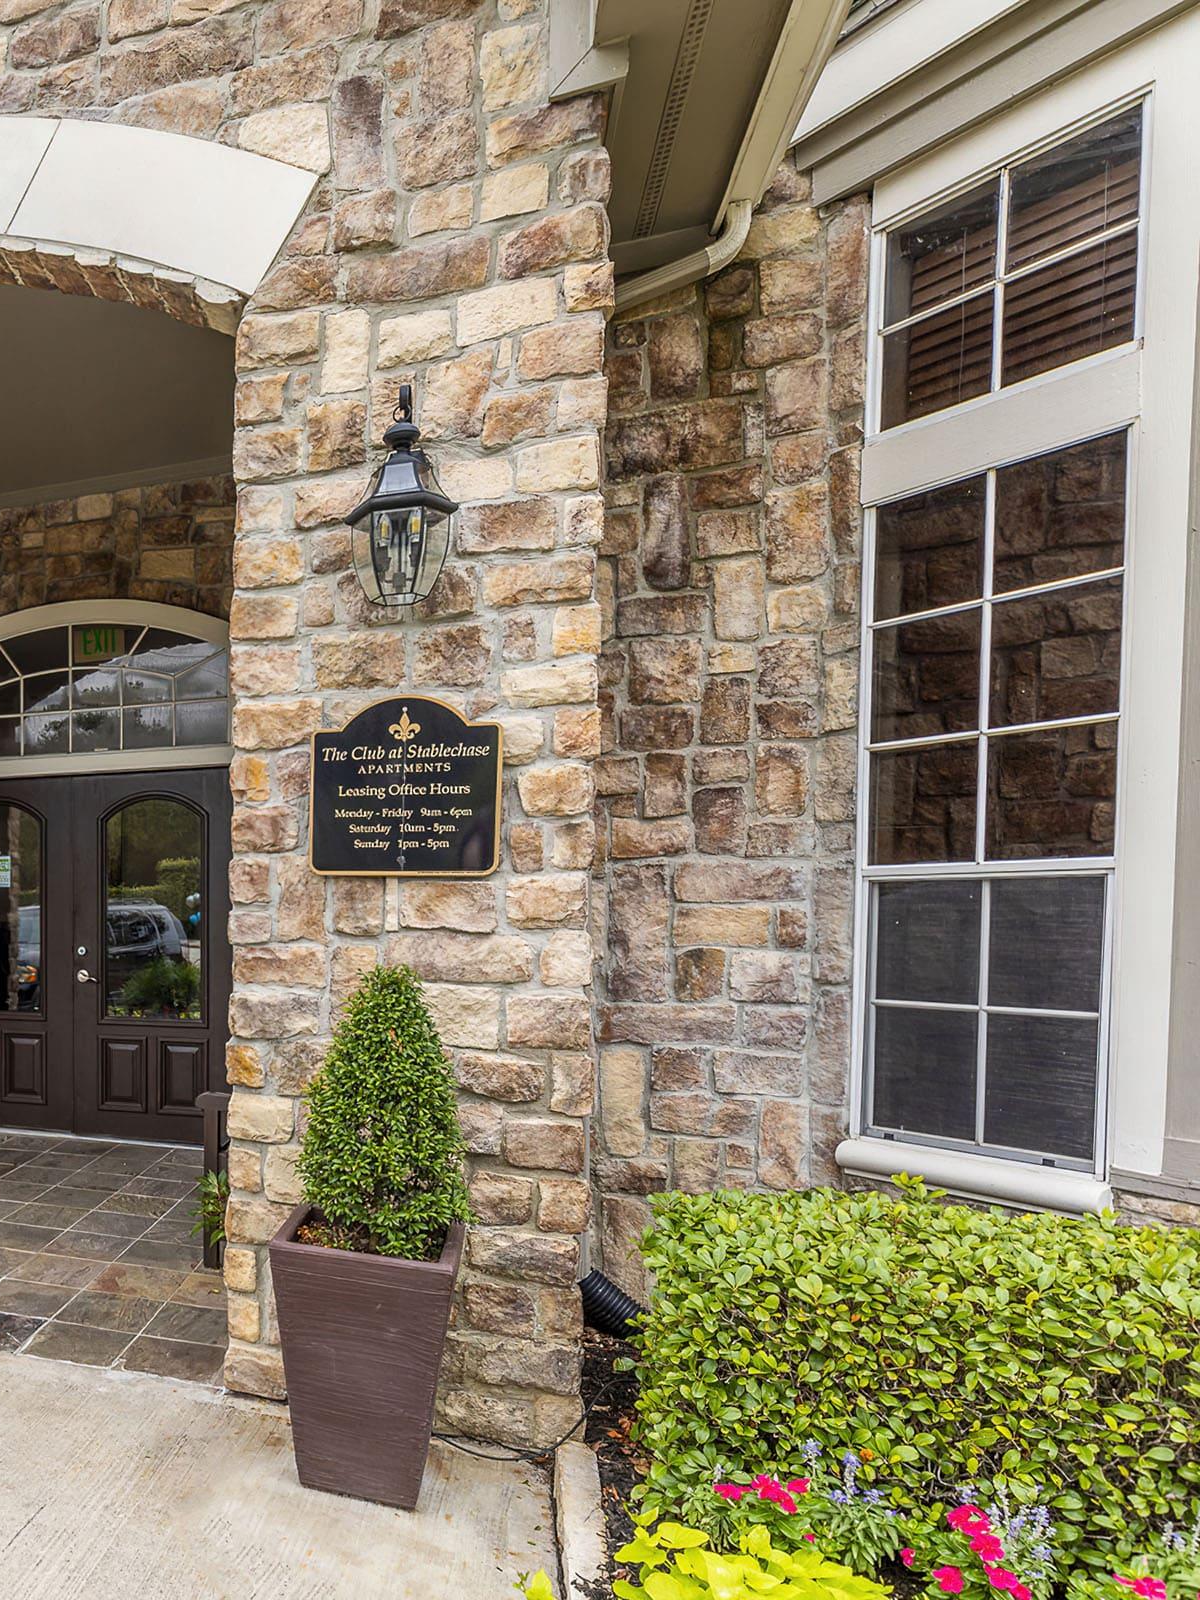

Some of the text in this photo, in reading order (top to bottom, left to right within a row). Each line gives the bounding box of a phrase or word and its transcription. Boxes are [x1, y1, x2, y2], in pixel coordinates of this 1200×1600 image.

[82, 629, 117, 655] EXIT
[322, 742, 490, 761] The Club at Stablechase
[357, 762, 451, 775] APARTMENTS
[338, 783, 471, 800] Leasing Office Hours
[334, 808, 374, 821] Monday
[382, 808, 413, 820] Friday
[420, 807, 442, 817] 9am
[450, 807, 473, 819] 6pm
[349, 823, 392, 835] Saturday
[399, 823, 425, 833] 10am
[353, 839, 391, 851] Sunday
[397, 839, 419, 850] 1pm
[427, 838, 450, 851] 5pm
